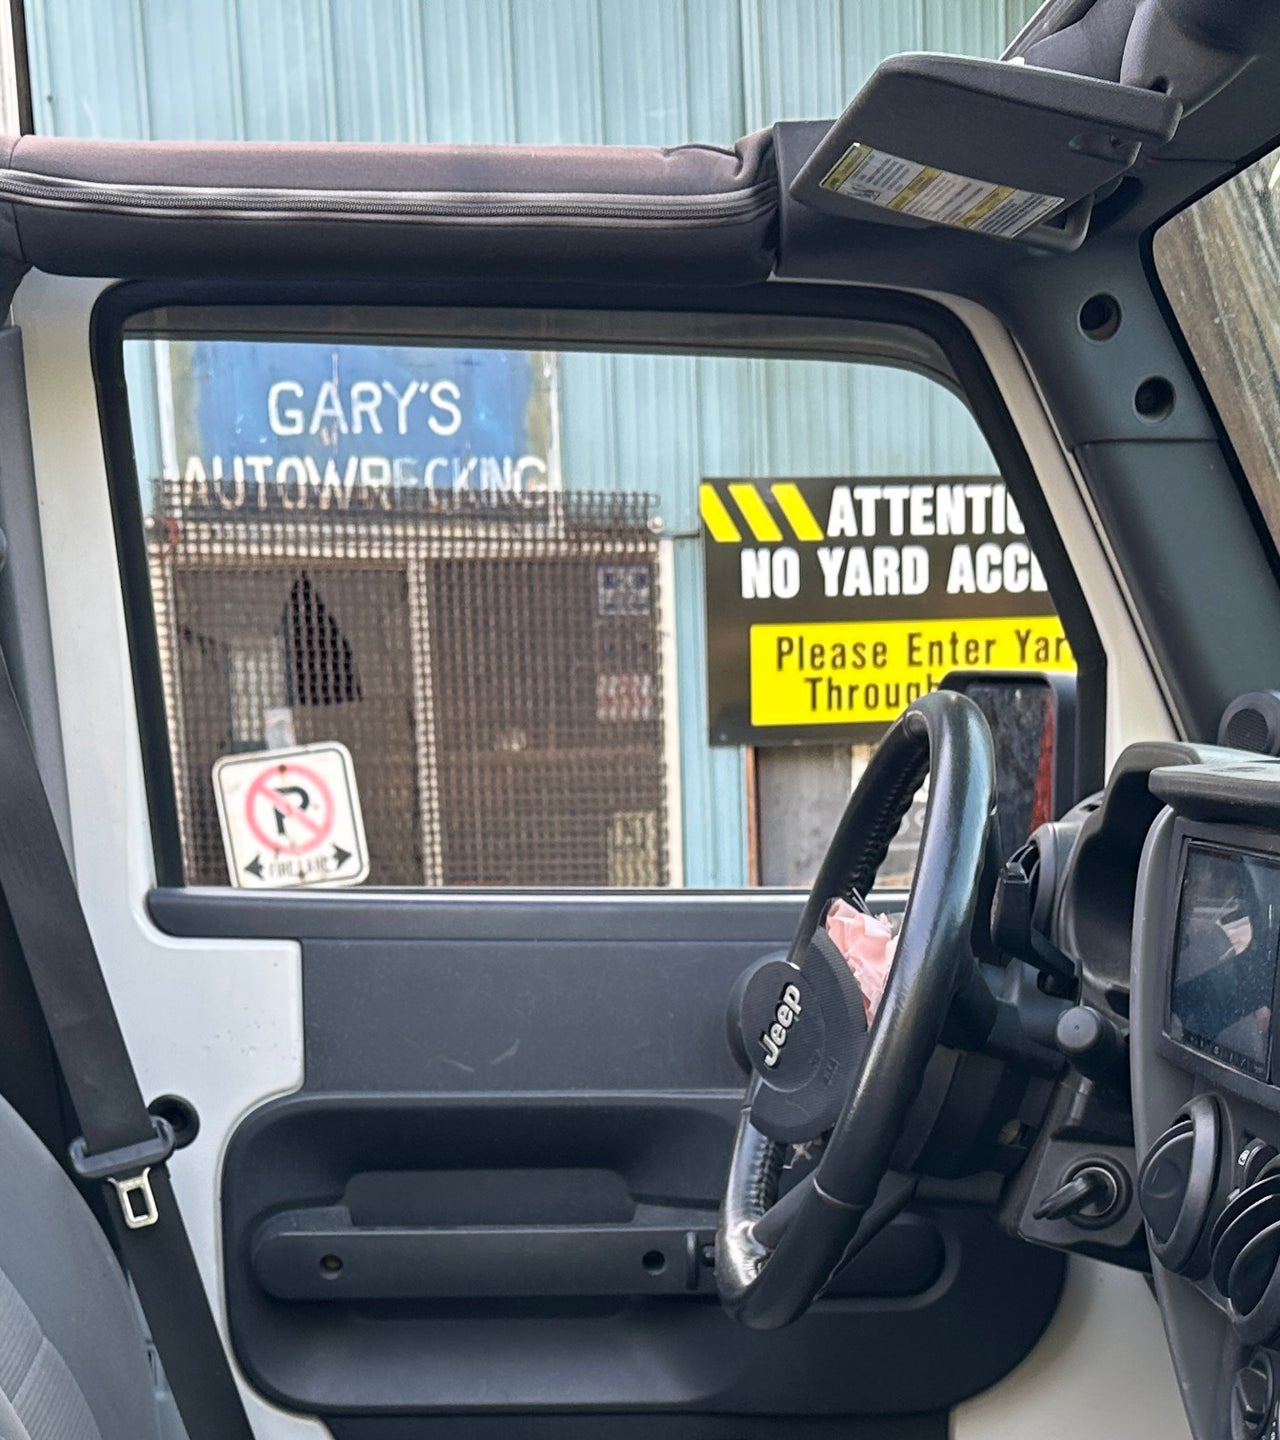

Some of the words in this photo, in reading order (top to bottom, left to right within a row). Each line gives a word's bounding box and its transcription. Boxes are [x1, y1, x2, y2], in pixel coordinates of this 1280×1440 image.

[268, 380, 462, 436] GARY'S
[183, 455, 548, 511] AUTOWRECKING
[740, 548, 801, 599] NO
[816, 546, 929, 597] YARD
[776, 635, 888, 671] Please
[907, 631, 996, 667] Enter
[1014, 629, 1070, 663] Yar
[761, 983, 803, 1067] Jeep
